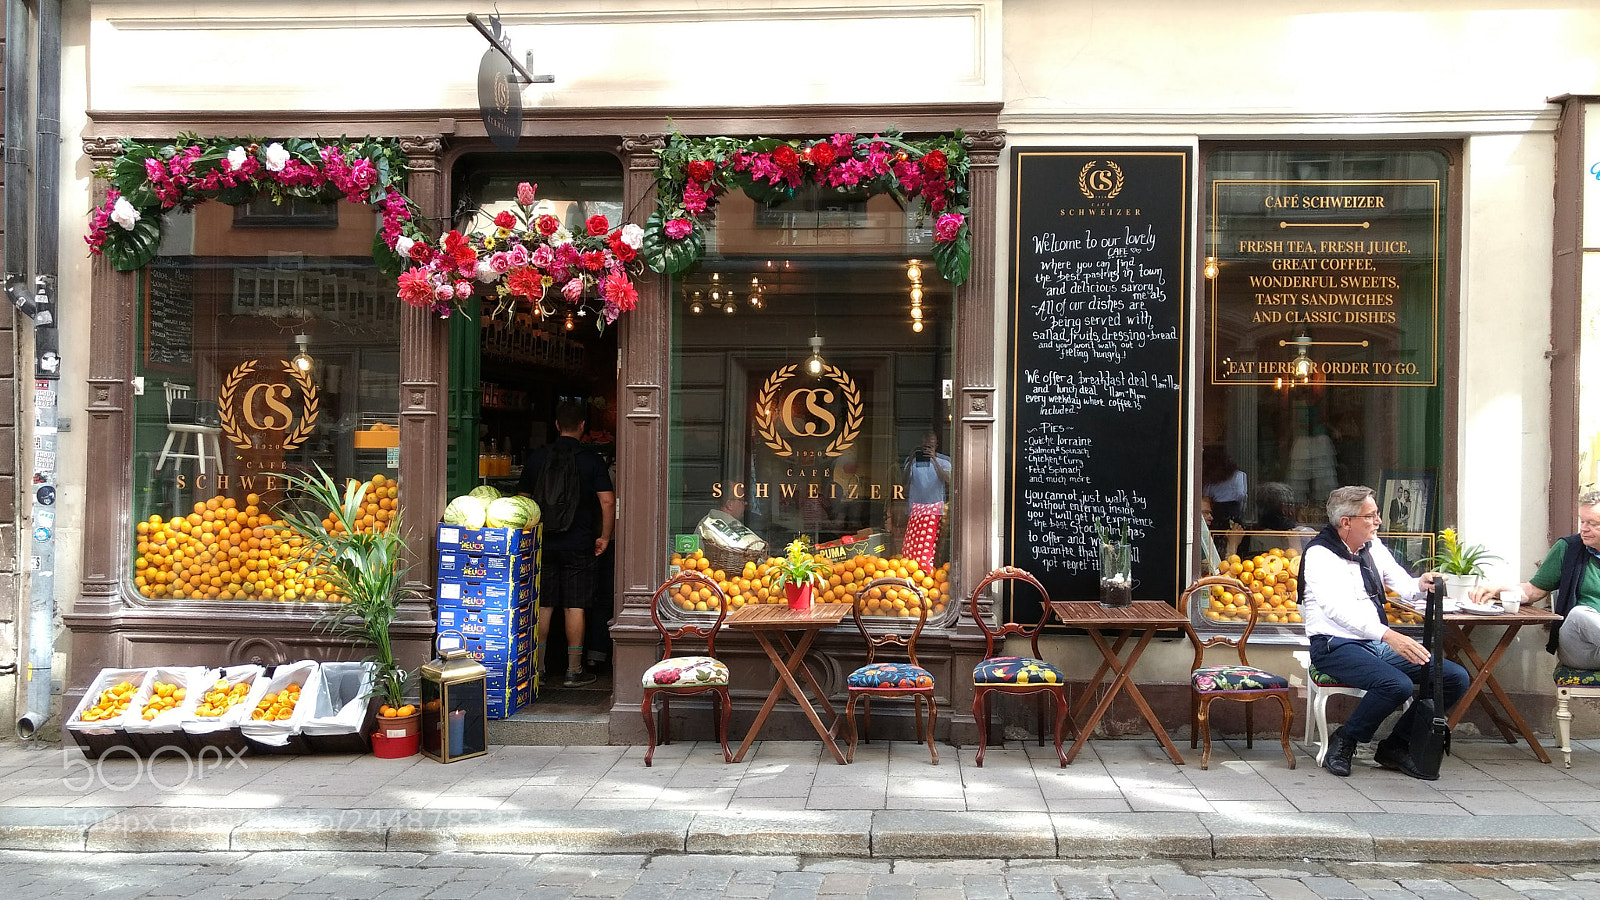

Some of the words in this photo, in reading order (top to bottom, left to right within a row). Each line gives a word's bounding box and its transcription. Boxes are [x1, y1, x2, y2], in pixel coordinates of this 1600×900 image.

[1090, 170, 1113, 190] CS
[1265, 194, 1299, 208] CAFÉ
[1302, 196, 1385, 208] SCHWEIZER
[1032, 233, 1082, 254] Welcome
[1086, 230, 1097, 249] to
[1101, 237, 1121, 248] our
[1125, 224, 1156, 252] lovely
[1239, 241, 1283, 252] FRESH
[1287, 241, 1317, 254] TEA,
[1320, 241, 1364, 253] FRESH
[1367, 241, 1411, 254] JUICE,
[1040, 258, 1071, 275] where
[1076, 262, 1092, 273] you
[1096, 261, 1110, 272] can
[1113, 257, 1135, 280] find
[1272, 258, 1317, 270] GREAT
[1320, 258, 1376, 272] COFFEE,
[1034, 274, 1052, 289] the
[1056, 271, 1080, 282] best
[1122, 270, 1134, 282] in
[1139, 264, 1165, 285] town
[1250, 276, 1337, 288] WONDERFUL
[1340, 276, 1400, 289] SWEETS,
[1046, 282, 1066, 296] and
[1070, 281, 1117, 294] delicious
[1121, 284, 1153, 294] savory
[1133, 287, 1166, 302] meals
[1056, 298, 1066, 316] of
[1070, 302, 1086, 310] our
[1089, 295, 1124, 312] dishes
[1129, 301, 1146, 310] are
[1255, 293, 1298, 305] TASTY
[1302, 294, 1393, 306] SANDWICHES
[1085, 312, 1121, 326] served
[1126, 311, 1154, 329] with
[1252, 311, 1282, 323] AND
[1285, 311, 1341, 323] CLASSIC
[1345, 311, 1396, 323] DISHES
[1102, 327, 1146, 347] dressing
[1056, 343, 1068, 351] you
[1098, 341, 1117, 352] walk
[1059, 348, 1088, 363] feeling
[1229, 362, 1254, 374] EAT
[1258, 362, 1294, 374] HERE
[1321, 362, 1369, 374] ORDER
[1372, 362, 1393, 374] TO
[1395, 362, 1419, 375] GO.
[1025, 369, 1040, 384] We
[1043, 371, 1066, 385] offer
[1067, 375, 1076, 385] a
[1078, 371, 1125, 389] breakfast
[1128, 371, 1149, 387] deal
[1033, 384, 1049, 393] and
[1056, 384, 1078, 398] lunch
[1079, 385, 1098, 395] deal
[243, 383, 293, 430] CS
[1026, 395, 1046, 407] every
[1049, 395, 1081, 409] weekday
[1084, 396, 1105, 406] where
[1109, 398, 1133, 412] coffee
[782, 388, 836, 436] CS
[1028, 435, 1055, 446] Quiche
[1029, 445, 1056, 454] Salmon
[1061, 447, 1090, 458] Spinach
[246, 461, 287, 470] CAFÉ
[1028, 454, 1059, 466] Chicken
[1064, 456, 1084, 468] Curry
[786, 468, 830, 477] CAFÉ
[1029, 466, 1045, 474] Feta
[1049, 466, 1082, 477] Spinach
[1029, 474, 1044, 483] and
[1046, 475, 1067, 485] much
[712, 482, 905, 500] SCHWEIZER
[1045, 489, 1078, 500] cannot
[1081, 490, 1100, 504] just
[1105, 490, 1130, 507] walk
[1132, 490, 1146, 509] by
[1032, 500, 1066, 514] without
[1070, 500, 1107, 518] entering
[1109, 504, 1135, 517] inside
[1027, 511, 1043, 521] you
[1055, 511, 1071, 520] will
[1074, 512, 1088, 524] get
[1106, 515, 1155, 528] experience
[1034, 519, 1048, 532] the
[1050, 518, 1068, 530] best
[1127, 526, 1146, 540] has
[1028, 530, 1038, 542] to
[1042, 531, 1064, 546] offer
[1068, 533, 1086, 544] and
[820, 546, 847, 559] PUMA
[1032, 544, 1076, 560] guarantee
[1078, 546, 1098, 561] that
[1043, 556, 1058, 572] not
[1062, 559, 1087, 575] regret
